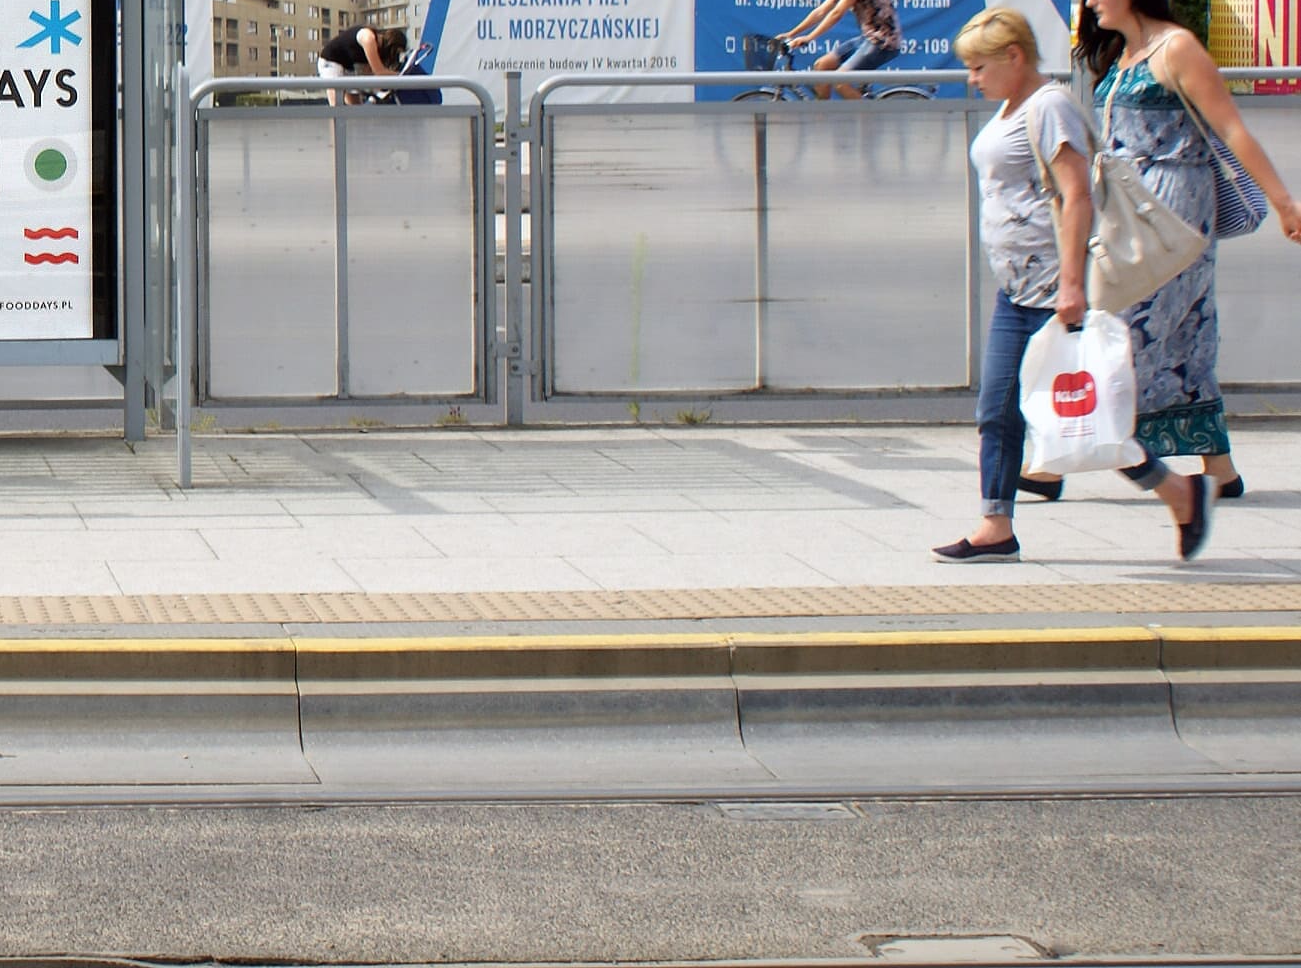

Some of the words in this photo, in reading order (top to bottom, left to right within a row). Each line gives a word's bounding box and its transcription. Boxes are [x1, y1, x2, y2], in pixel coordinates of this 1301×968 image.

[477, 20, 502, 40] UL.
[509, 14, 660, 40] MORZYCZAŃSKIEJ
[549, 57, 588, 71] budowy
[592, 57, 603, 68] IV
[650, 56, 677, 68] 2016
